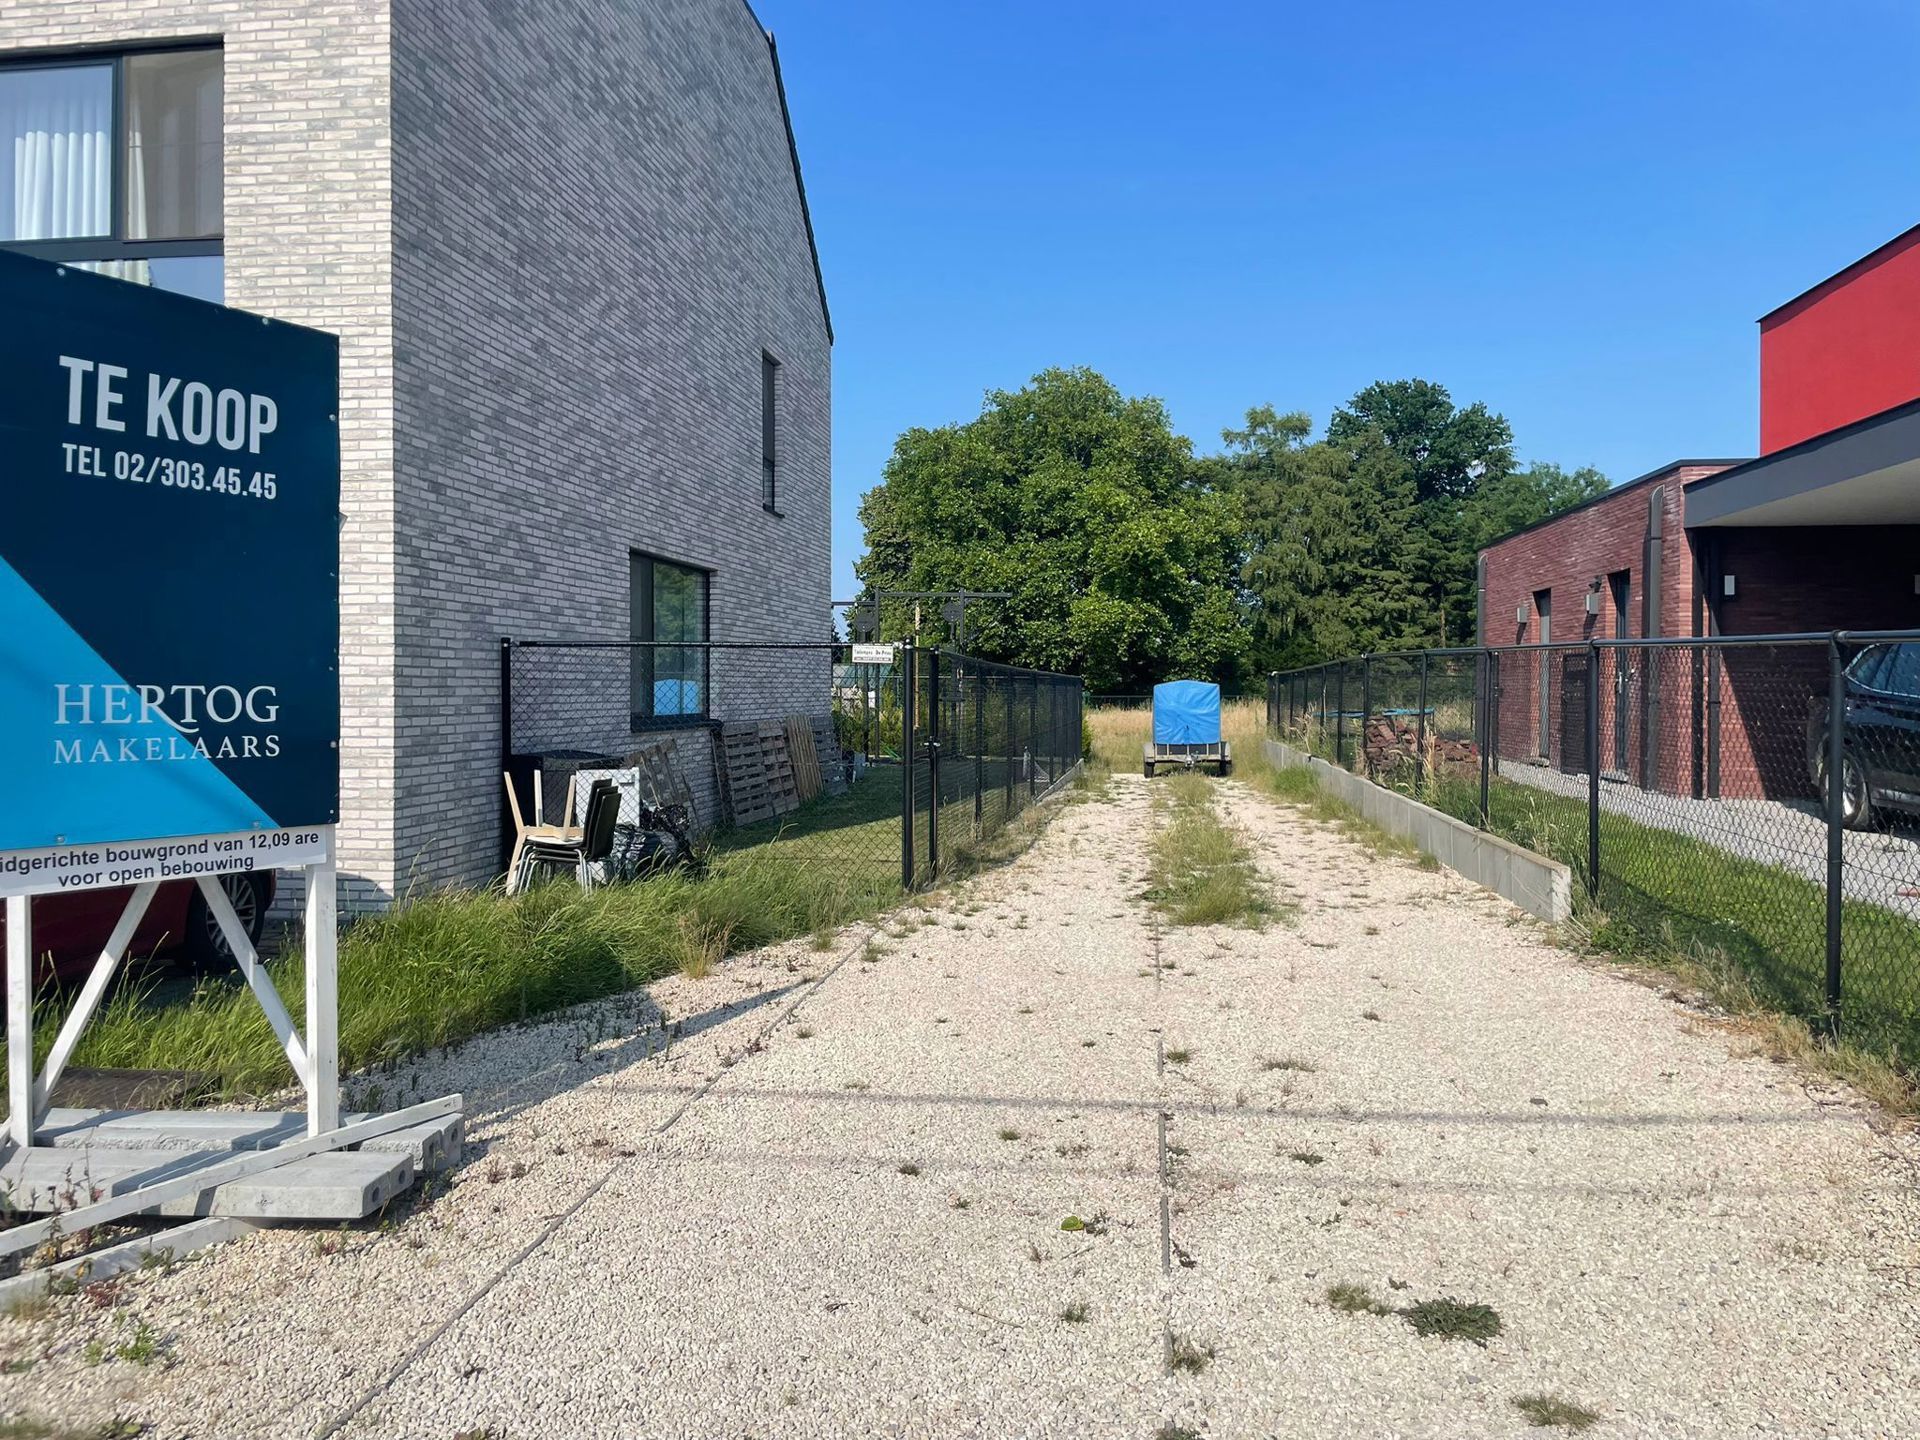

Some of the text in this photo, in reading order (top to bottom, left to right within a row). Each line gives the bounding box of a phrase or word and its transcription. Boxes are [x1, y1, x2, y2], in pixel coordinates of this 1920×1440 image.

[59, 355, 278, 454] TE KOOP
[62, 442, 277, 500] TEL 02/303.45.45
[54, 684, 280, 733] HERTOG
[53, 735, 280, 764] MAKELAARS
[106, 840, 208, 861] bouwgrond
[214, 839, 243, 852] van
[249, 832, 290, 849] 12,09
[295, 833, 319, 844] are
[58, 856, 254, 887] voor open bebouwing
